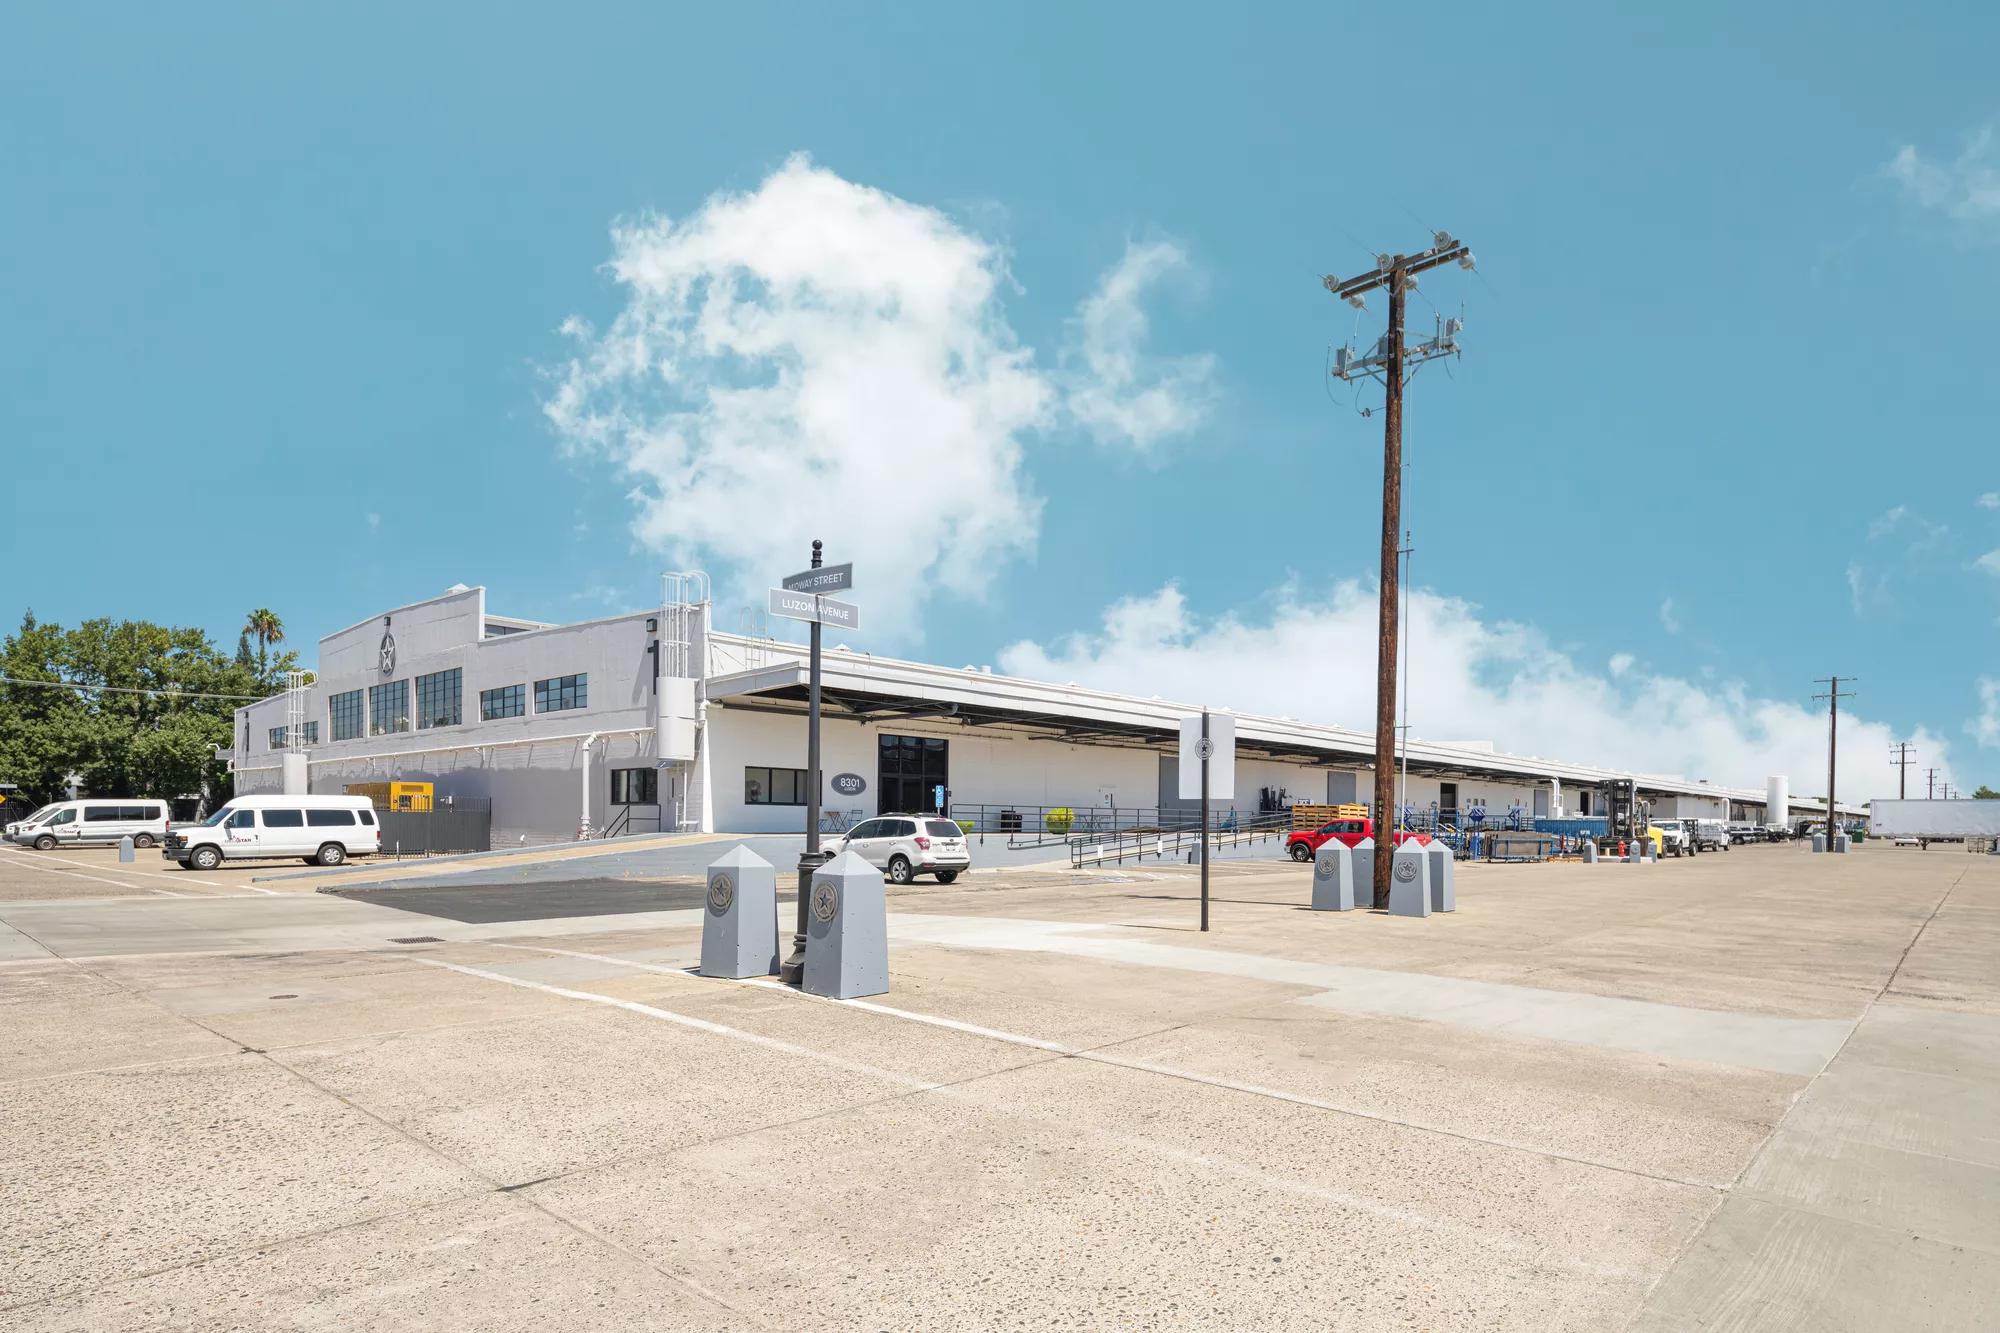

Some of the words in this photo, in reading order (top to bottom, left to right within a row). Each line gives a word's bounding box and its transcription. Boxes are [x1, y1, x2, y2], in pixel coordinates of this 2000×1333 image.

[814, 572, 844, 586] STREET
[782, 598, 815, 613] LUZON
[817, 604, 849, 620] AVENUE
[840, 777, 859, 787] 8301
